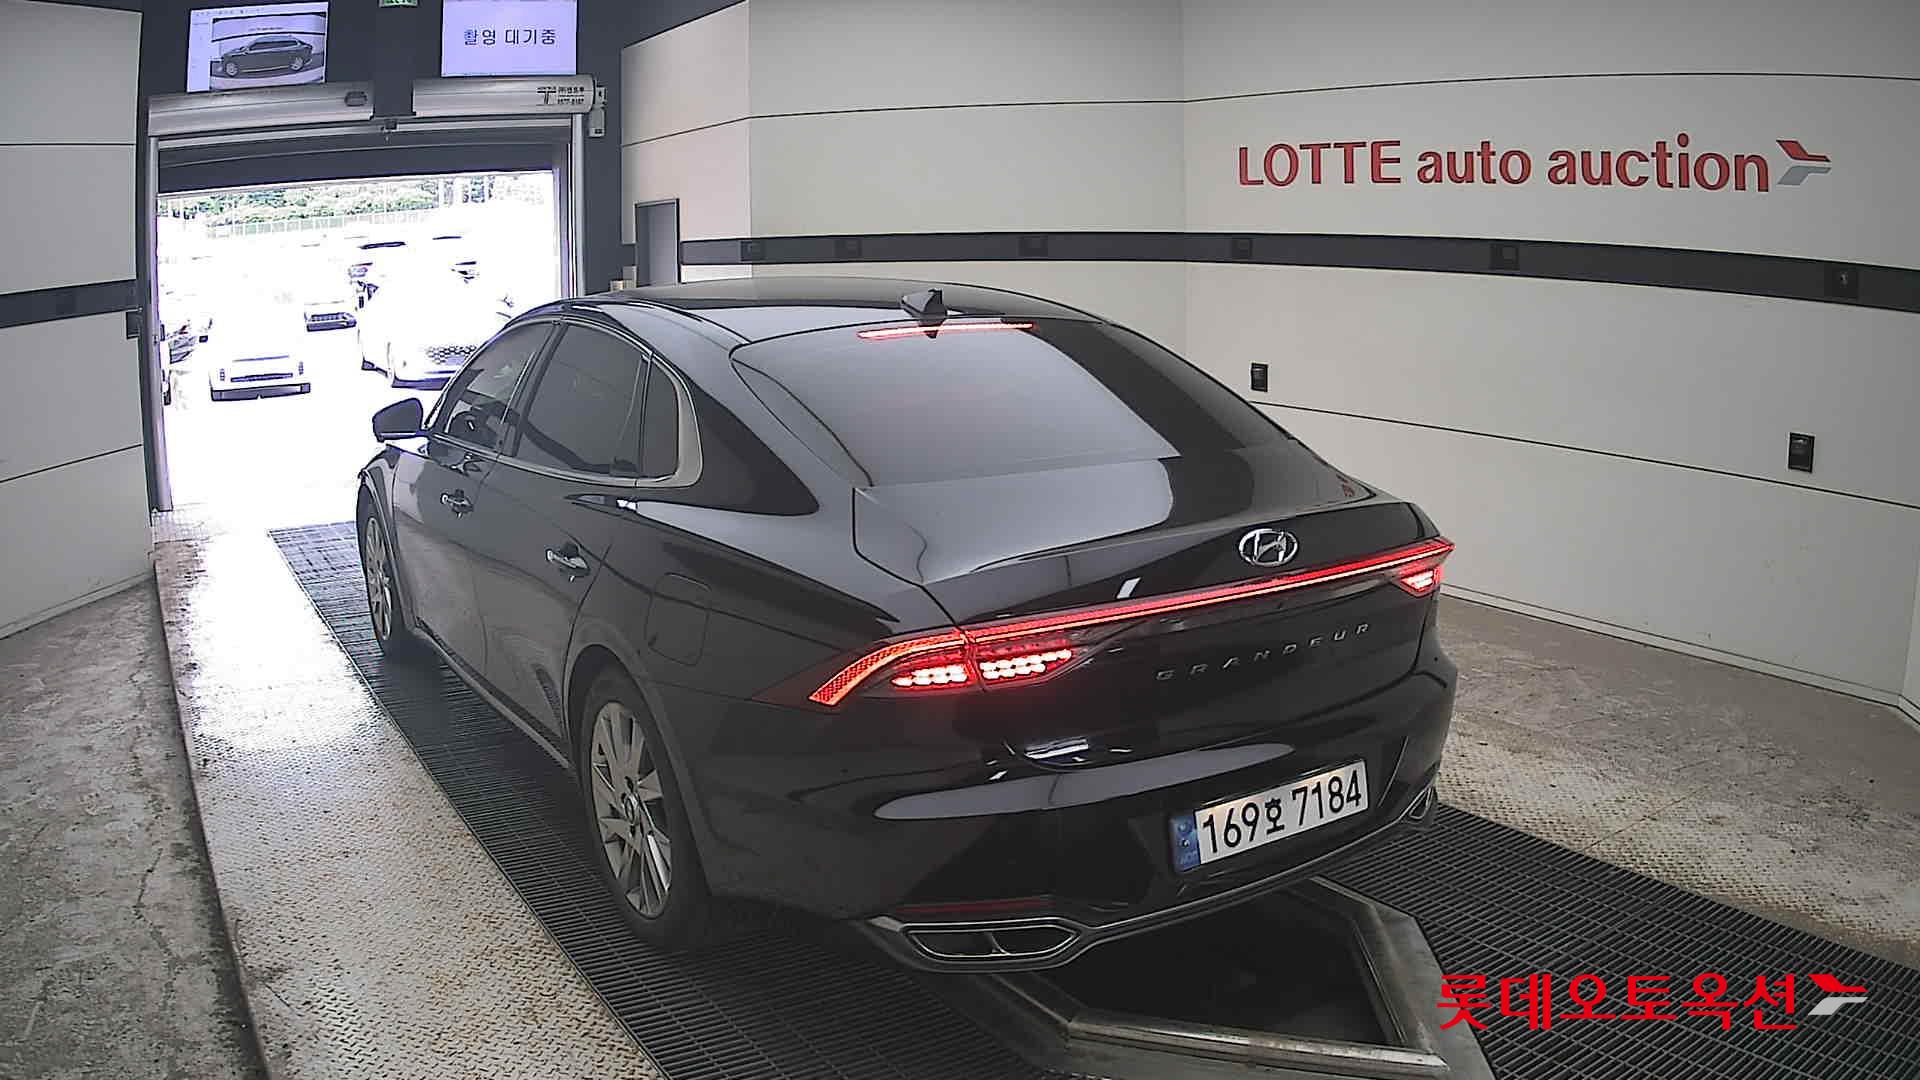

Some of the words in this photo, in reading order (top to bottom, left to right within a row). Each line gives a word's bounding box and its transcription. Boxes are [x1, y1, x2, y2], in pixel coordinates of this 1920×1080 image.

[505, 29, 556, 45] 대기중
[1239, 140, 1401, 187] LOTTE
[1417, 140, 1532, 185] auto
[1548, 133, 1769, 193] auction
[1156, 623, 1369, 681] GRANDEUR
[1203, 798, 1285, 854] 169호
[1292, 770, 1362, 827] 7184
